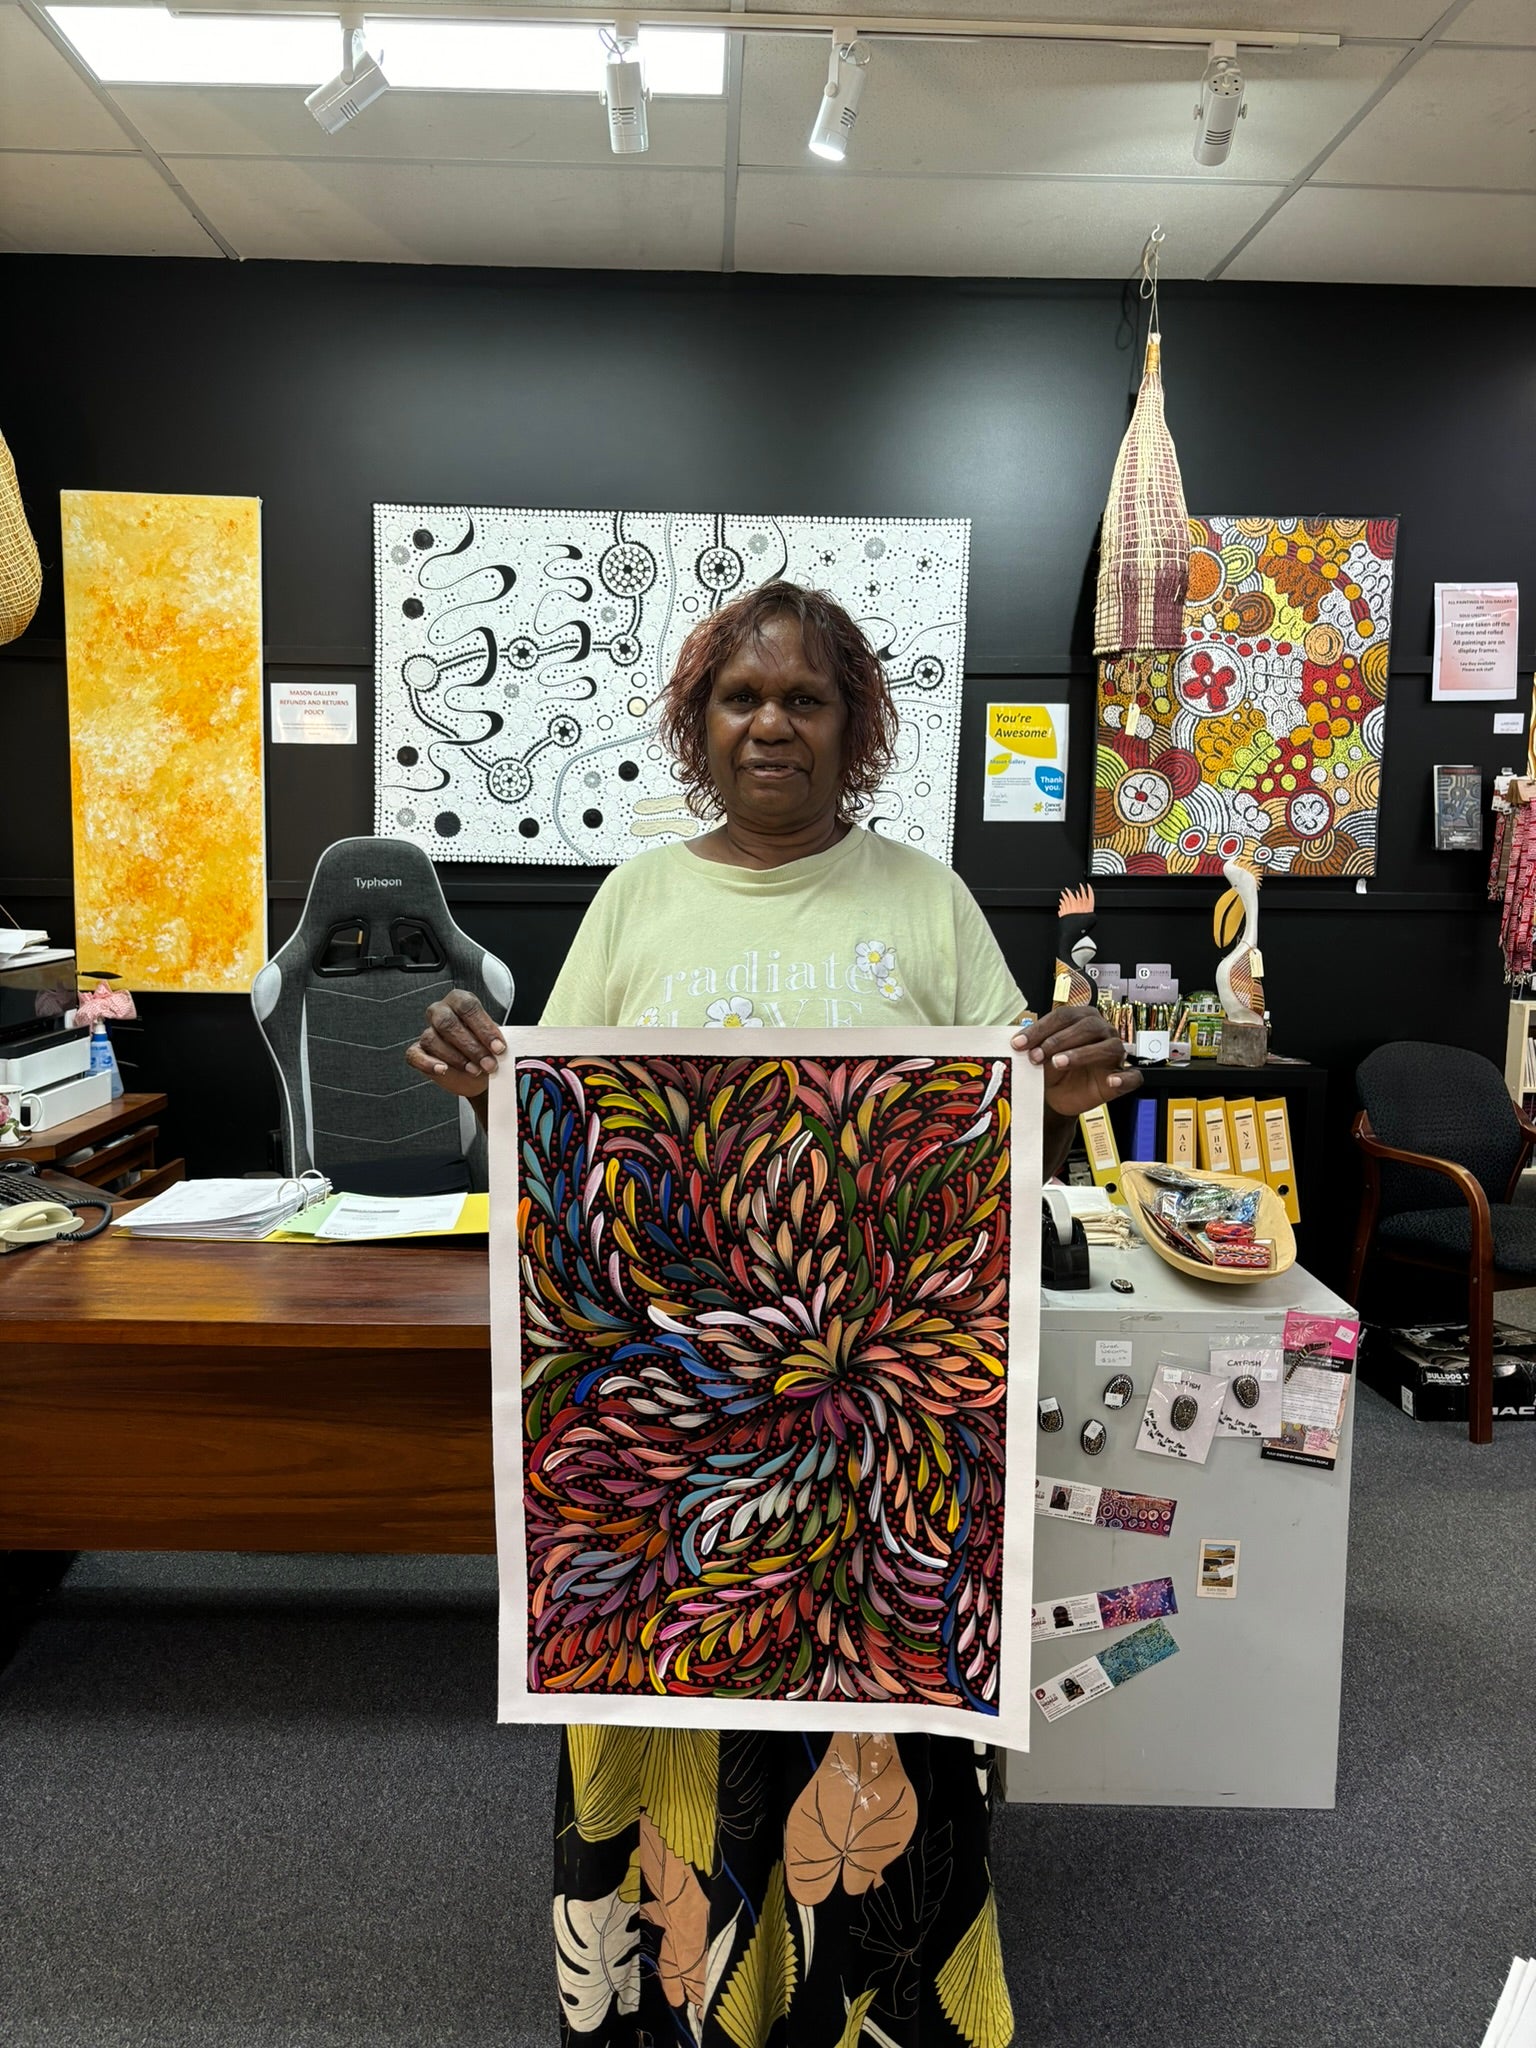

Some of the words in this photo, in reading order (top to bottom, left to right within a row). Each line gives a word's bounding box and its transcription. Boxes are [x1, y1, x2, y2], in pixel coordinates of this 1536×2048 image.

[996, 713, 1032, 723] You’re
[995, 728, 1052, 738] Awesome!
[353, 876, 402, 889] Typhoon
[660, 950, 874, 1003] radiate
[1243, 1130, 1249, 1138] N
[1245, 1142, 1251, 1150] Z
[1227, 1359, 1262, 1367] CATFISH
[1426, 1372, 1462, 1380] BULLDOG
